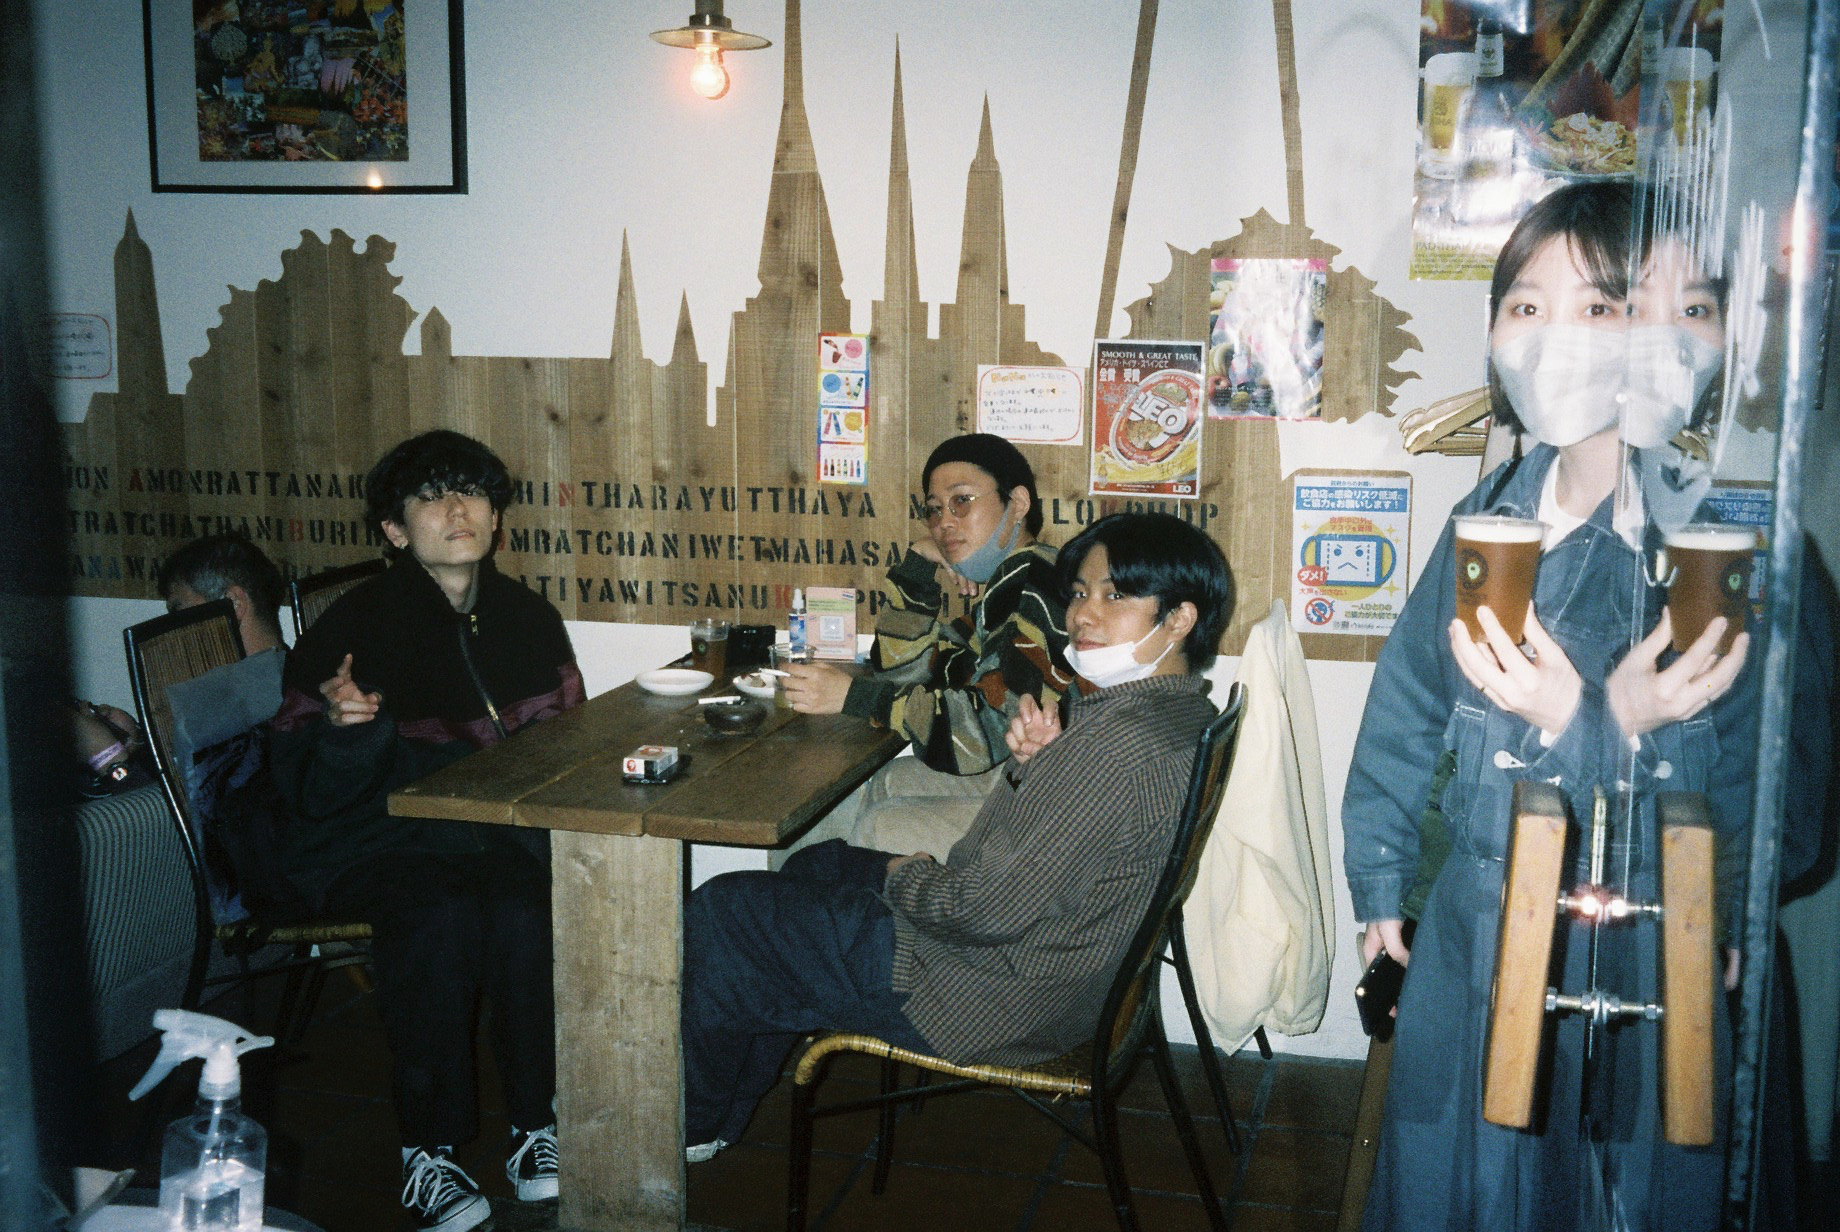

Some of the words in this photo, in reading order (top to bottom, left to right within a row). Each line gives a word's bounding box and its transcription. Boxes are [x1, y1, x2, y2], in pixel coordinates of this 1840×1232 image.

[1101, 351, 1136, 359] SMOOTH
[1147, 352, 1171, 360] GREAT
[1130, 389, 1188, 434] LEO
[129, 468, 364, 499] AMONRATTANAK
[513, 479, 876, 518] HINTHARAYUTTHAYA
[1172, 484, 1192, 493] LEO
